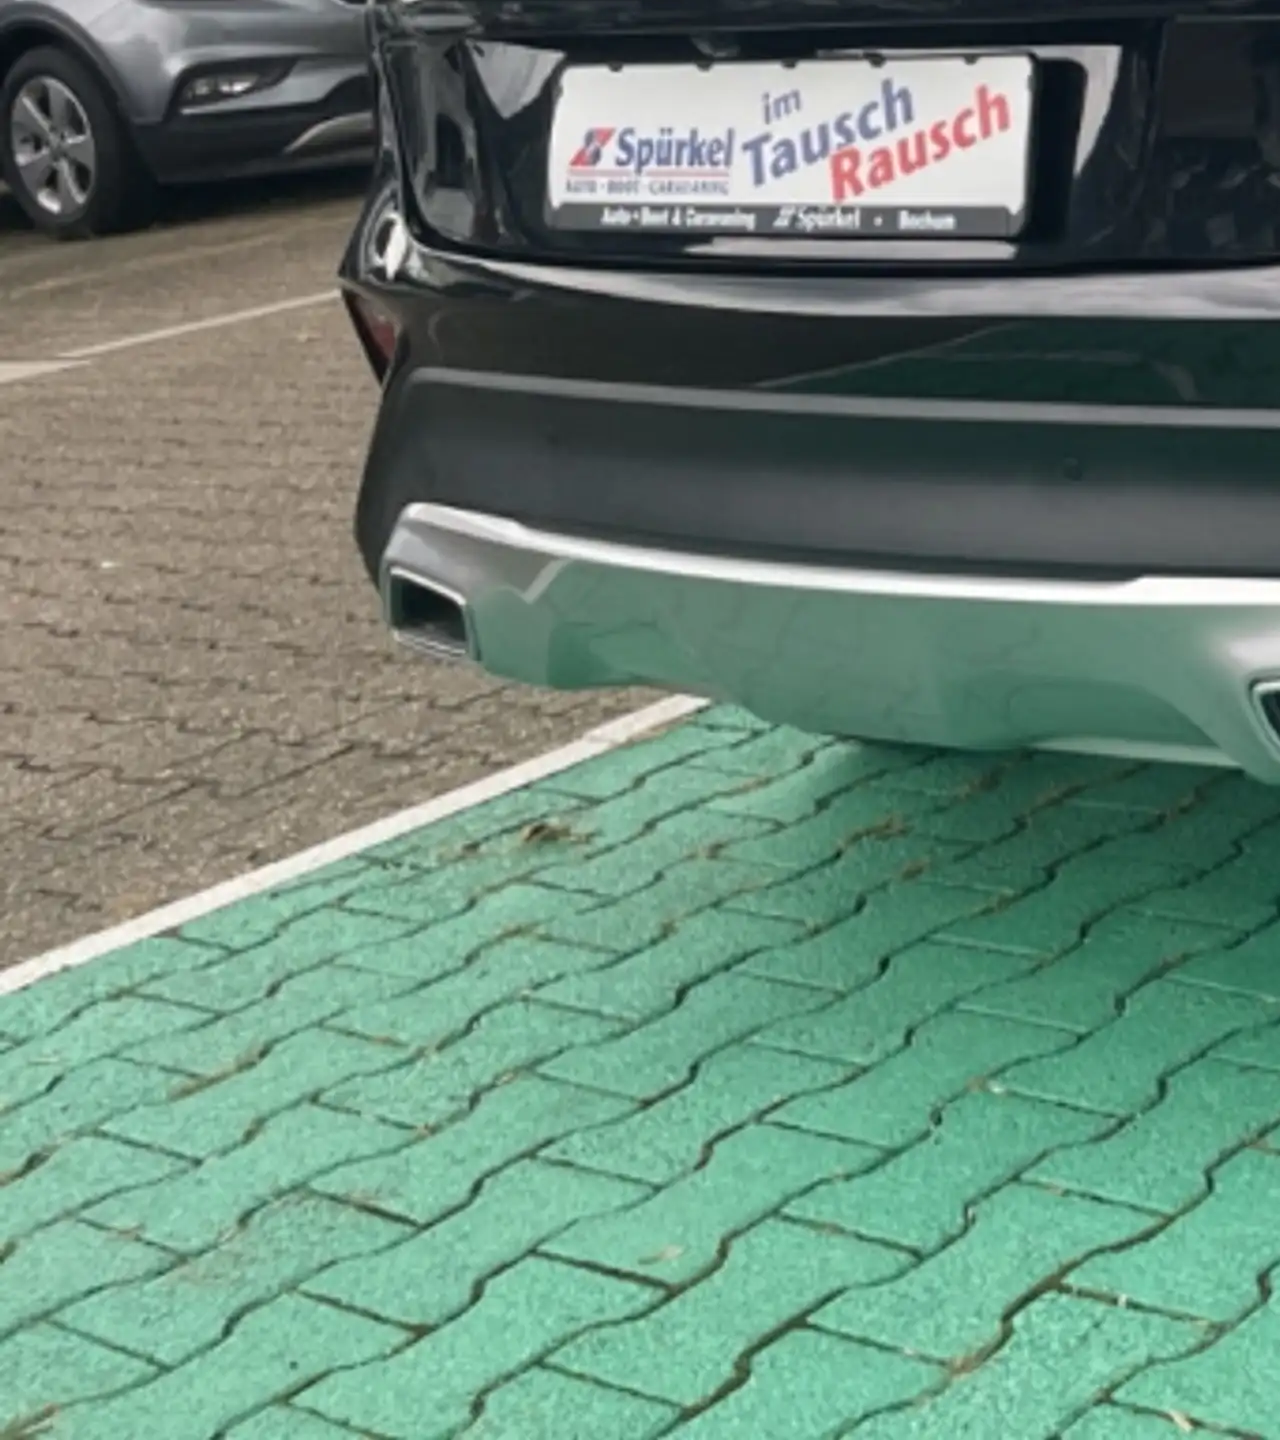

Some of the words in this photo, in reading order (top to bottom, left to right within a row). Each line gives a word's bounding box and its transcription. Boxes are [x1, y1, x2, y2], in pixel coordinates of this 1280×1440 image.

[741, 78, 915, 188] Tausch
[762, 89, 803, 125] im
[828, 83, 1012, 203] Rausch
[614, 126, 734, 177] Spürkel
